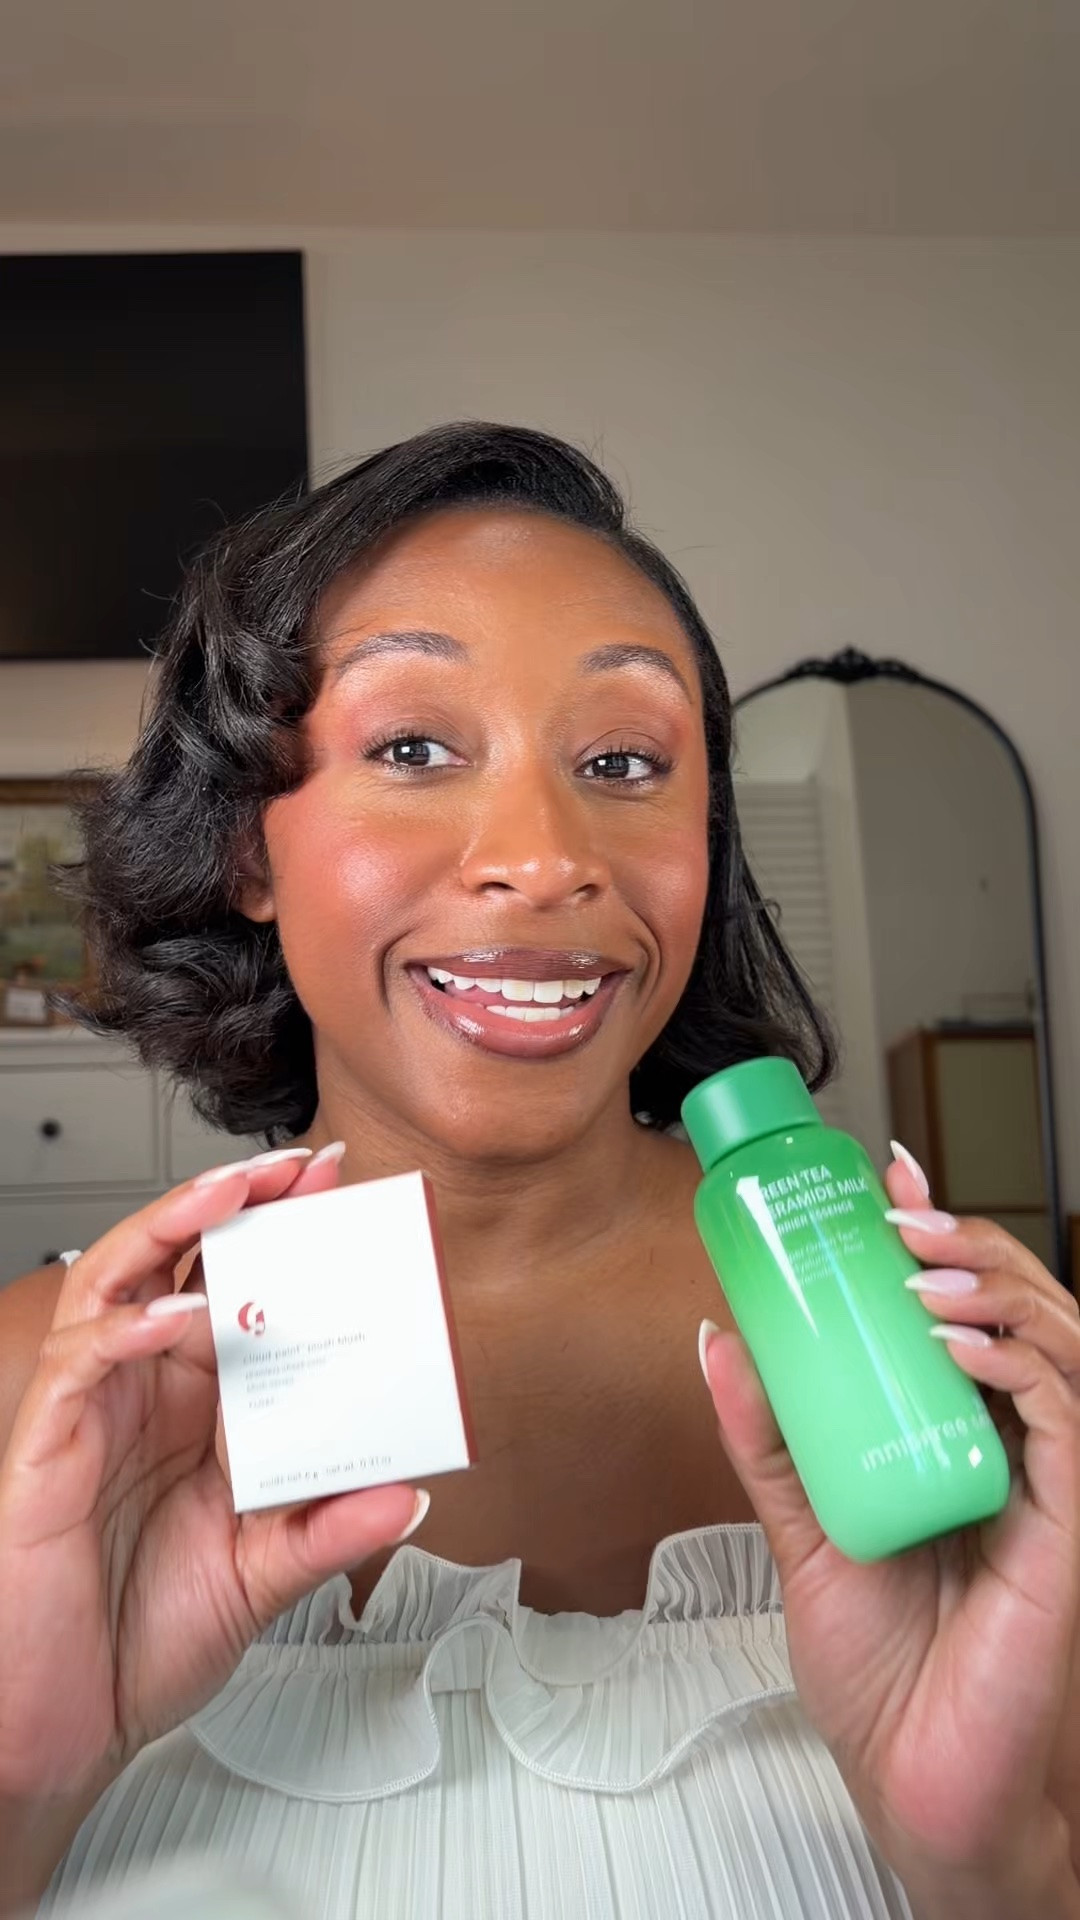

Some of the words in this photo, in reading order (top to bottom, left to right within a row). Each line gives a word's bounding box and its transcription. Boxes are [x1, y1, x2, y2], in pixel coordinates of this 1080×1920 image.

[759, 1172, 800, 1200] REEN
[800, 1164, 832, 1184] TEA
[767, 1183, 837, 1221] ERAMIDE
[837, 1176, 869, 1196] MILK
